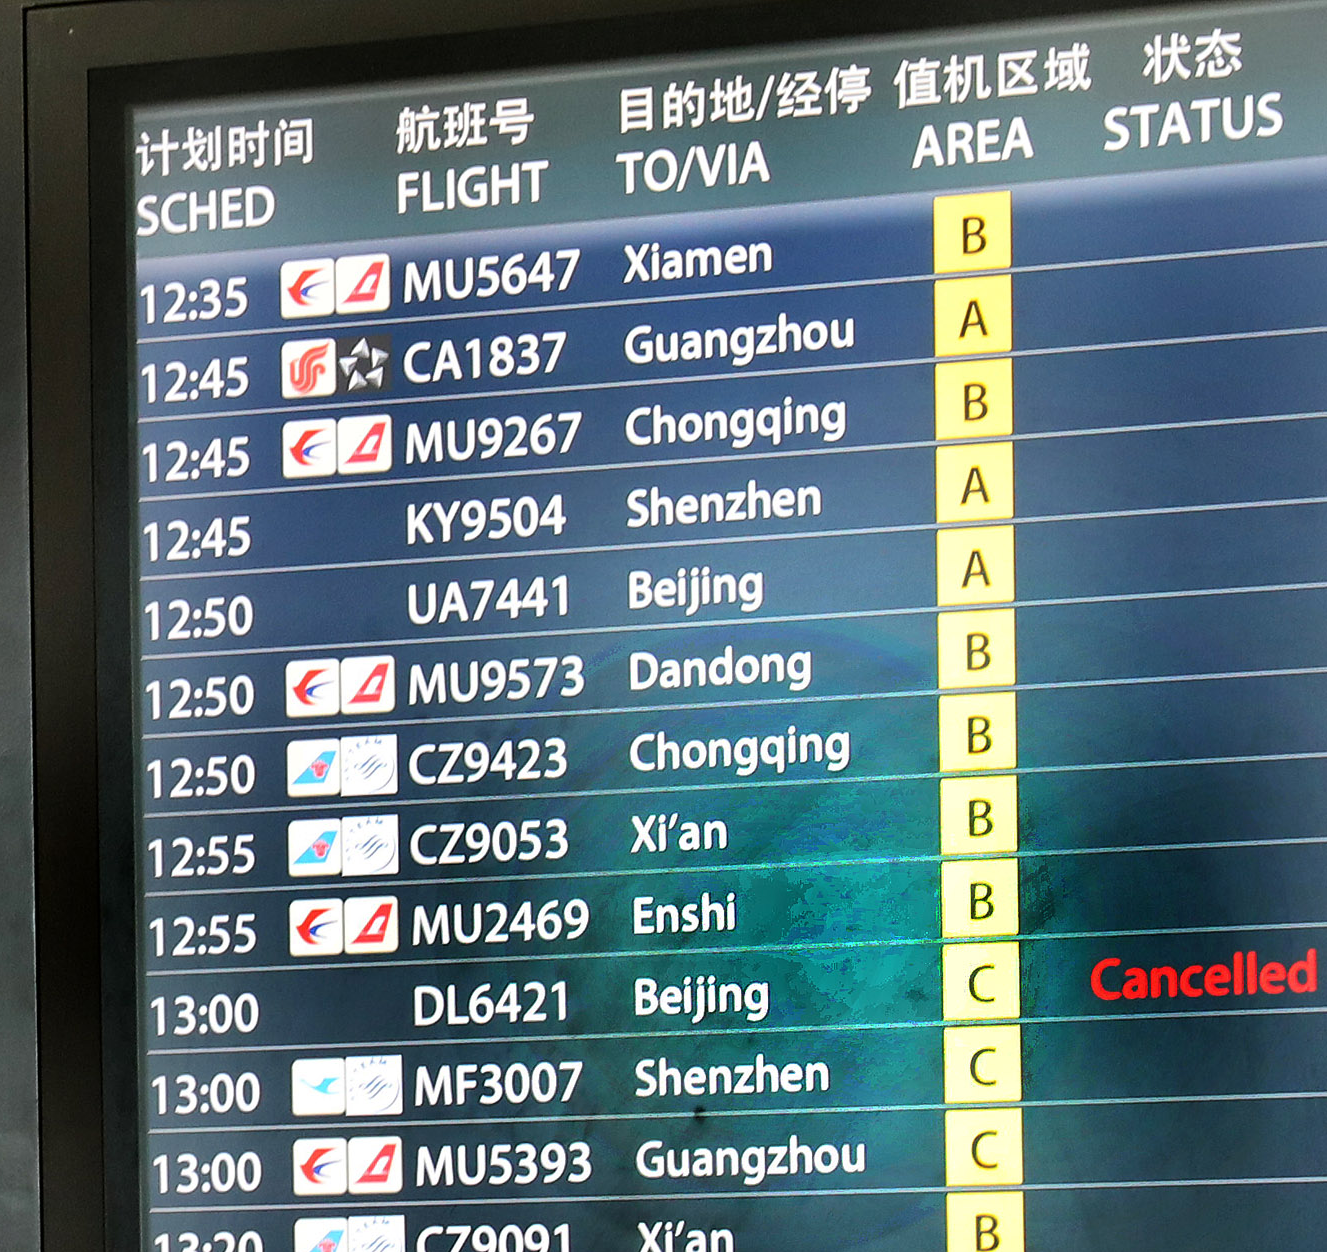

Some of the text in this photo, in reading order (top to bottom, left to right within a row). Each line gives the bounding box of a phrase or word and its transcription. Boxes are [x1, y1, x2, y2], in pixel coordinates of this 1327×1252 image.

[135, 28, 1243, 177] 计划时间 航班号 目的地/经停 值机区域 状态
[136, 91, 1284, 237] SCHED FLIGHT TO/VIA AREA STATUS
[140, 216, 987, 325] 12:35 MU5647 Xiamen B
[144, 549, 991, 641] 12:50 UA7441 Beijing A
[150, 947, 1318, 1036] 13:00 DL6421 Beijing C Cancelled
